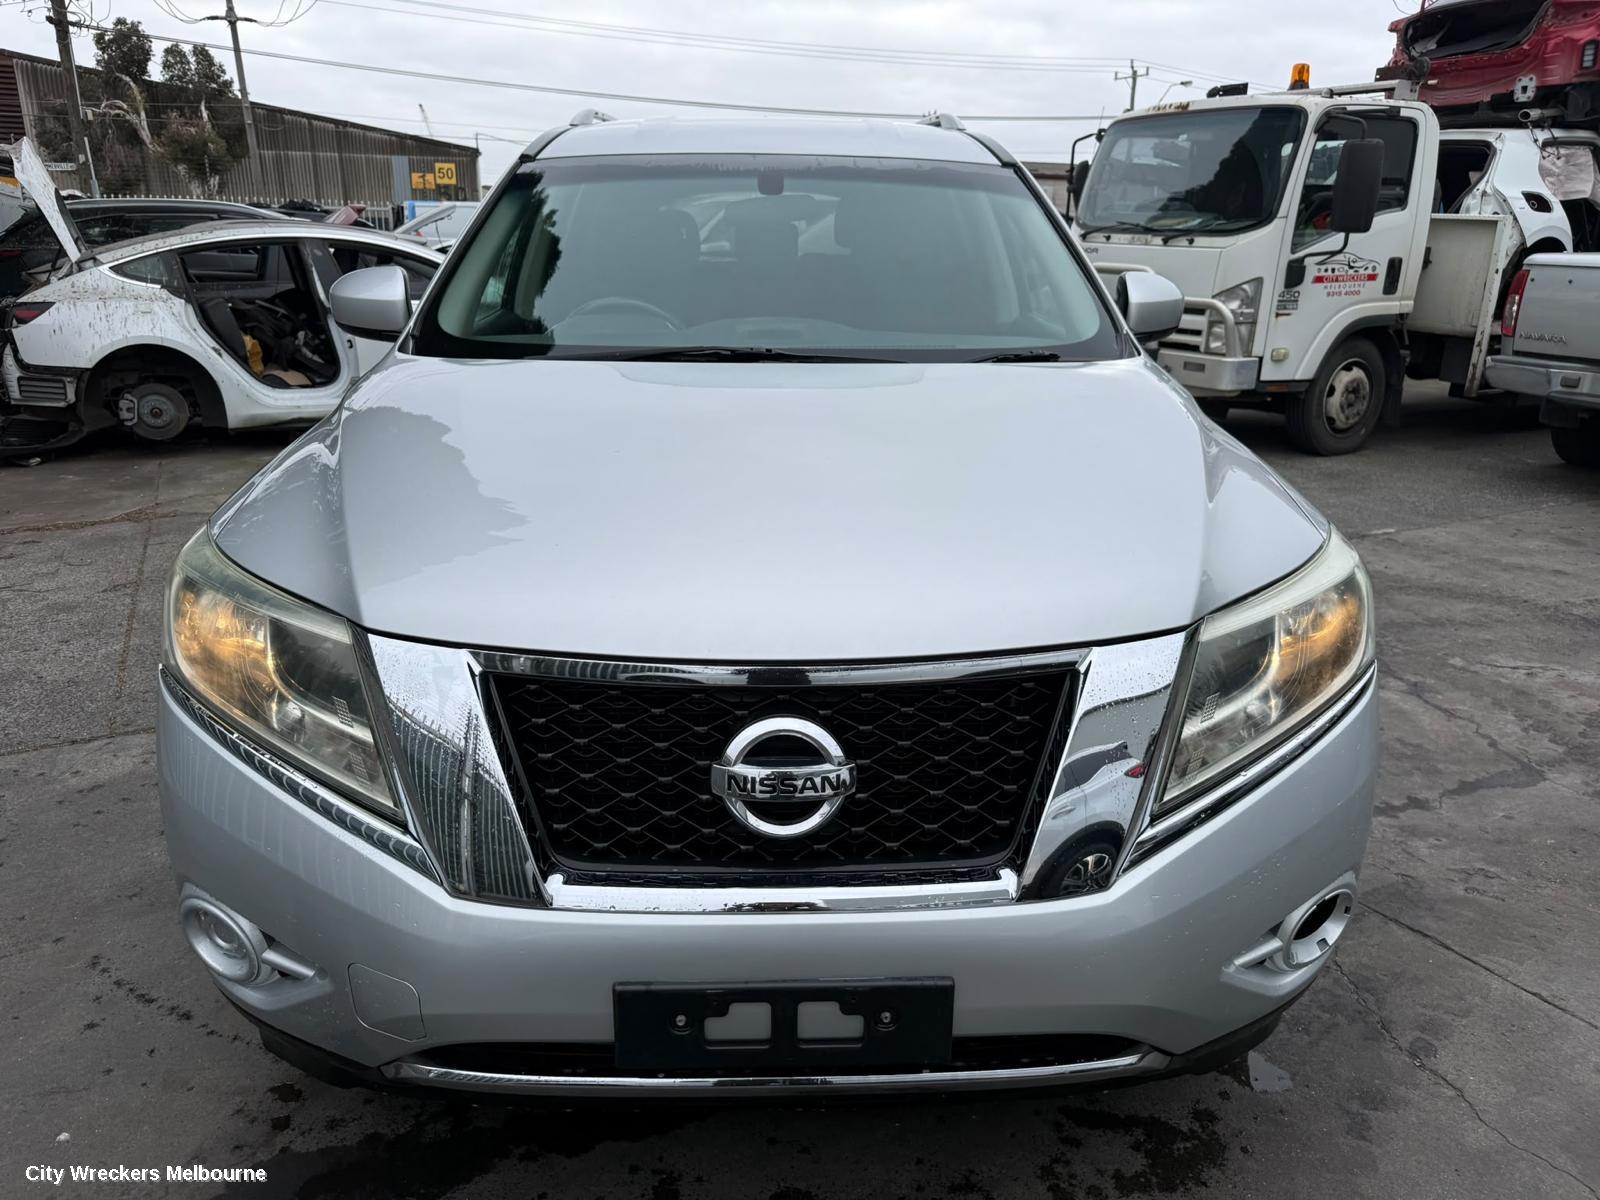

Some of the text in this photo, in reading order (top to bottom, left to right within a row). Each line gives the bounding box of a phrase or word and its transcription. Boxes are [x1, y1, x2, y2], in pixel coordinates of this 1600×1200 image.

[437, 167, 454, 180] 50
[1323, 273, 1368, 283] CITY WRECKERS
[1278, 290, 1300, 299] 450
[727, 773, 841, 795] NISSAN
